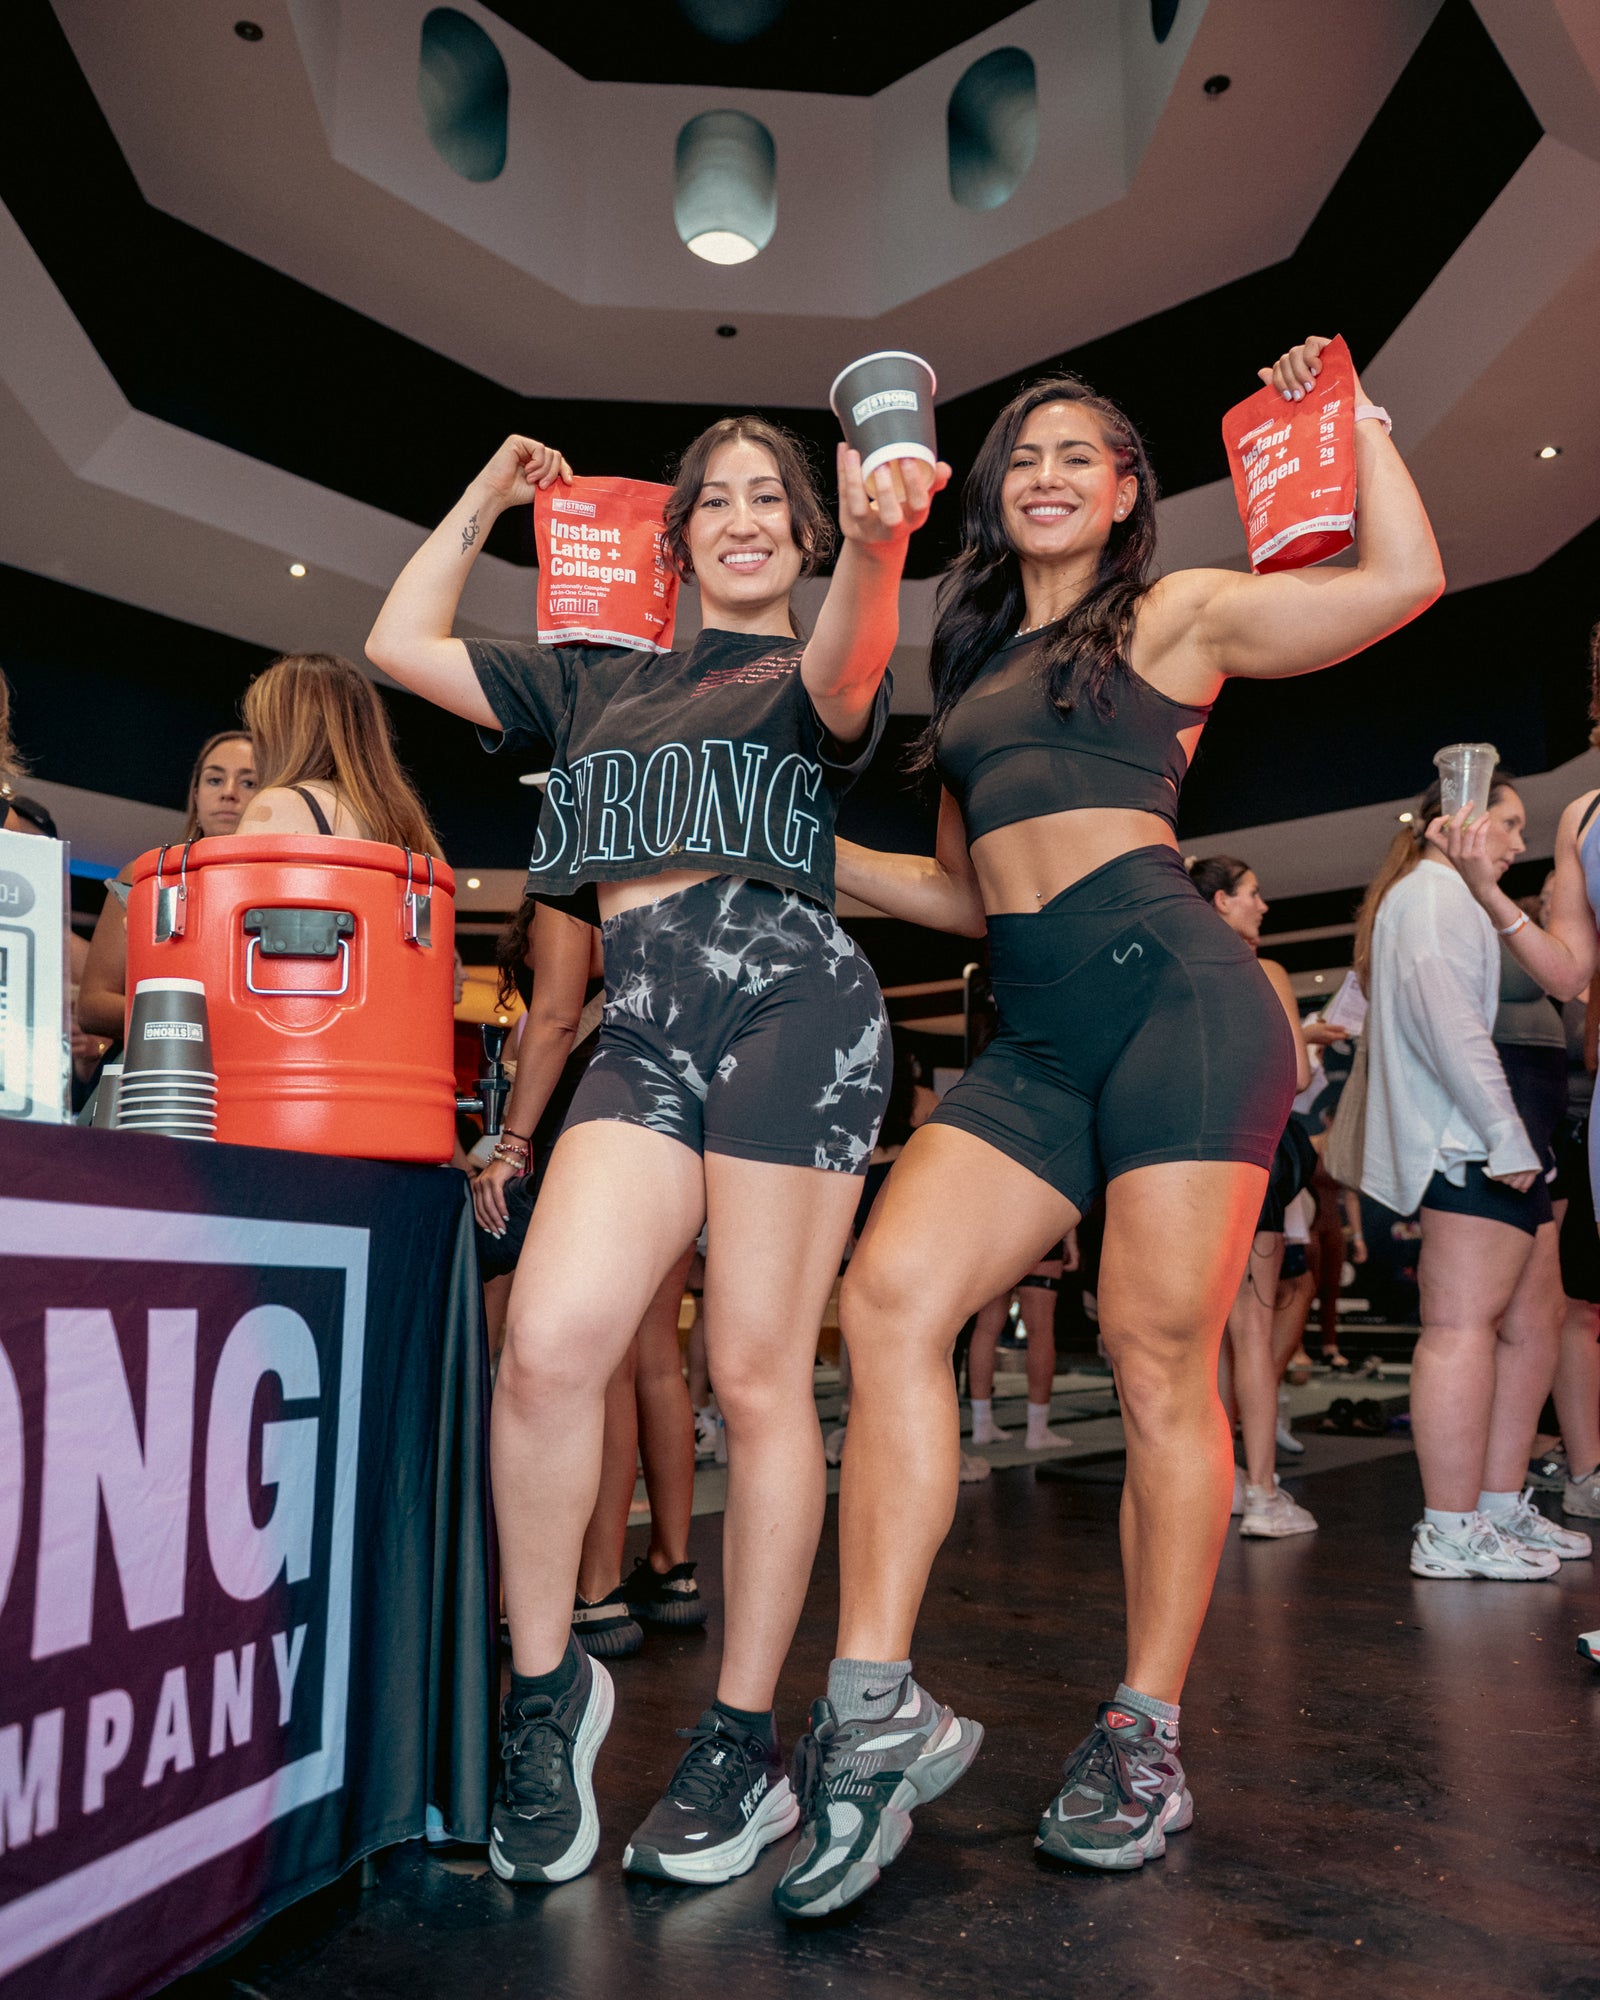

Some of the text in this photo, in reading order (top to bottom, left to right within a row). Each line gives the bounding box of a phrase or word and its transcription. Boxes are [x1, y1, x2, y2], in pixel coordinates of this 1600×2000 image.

[1320, 422, 1334, 434] 5g
[1320, 447, 1334, 458] 2g
[1310, 489, 1321, 499] 12
[551, 518, 621, 545] Instant
[551, 537, 621, 560] Latte +
[551, 557, 637, 584] Collagen
[654, 578, 665, 592] 2g
[549, 598, 599, 613] Vanilla
[644, 612, 653, 622] 12
[147, 1028, 187, 1038] STRONG
[0, 1304, 321, 1661] NG
